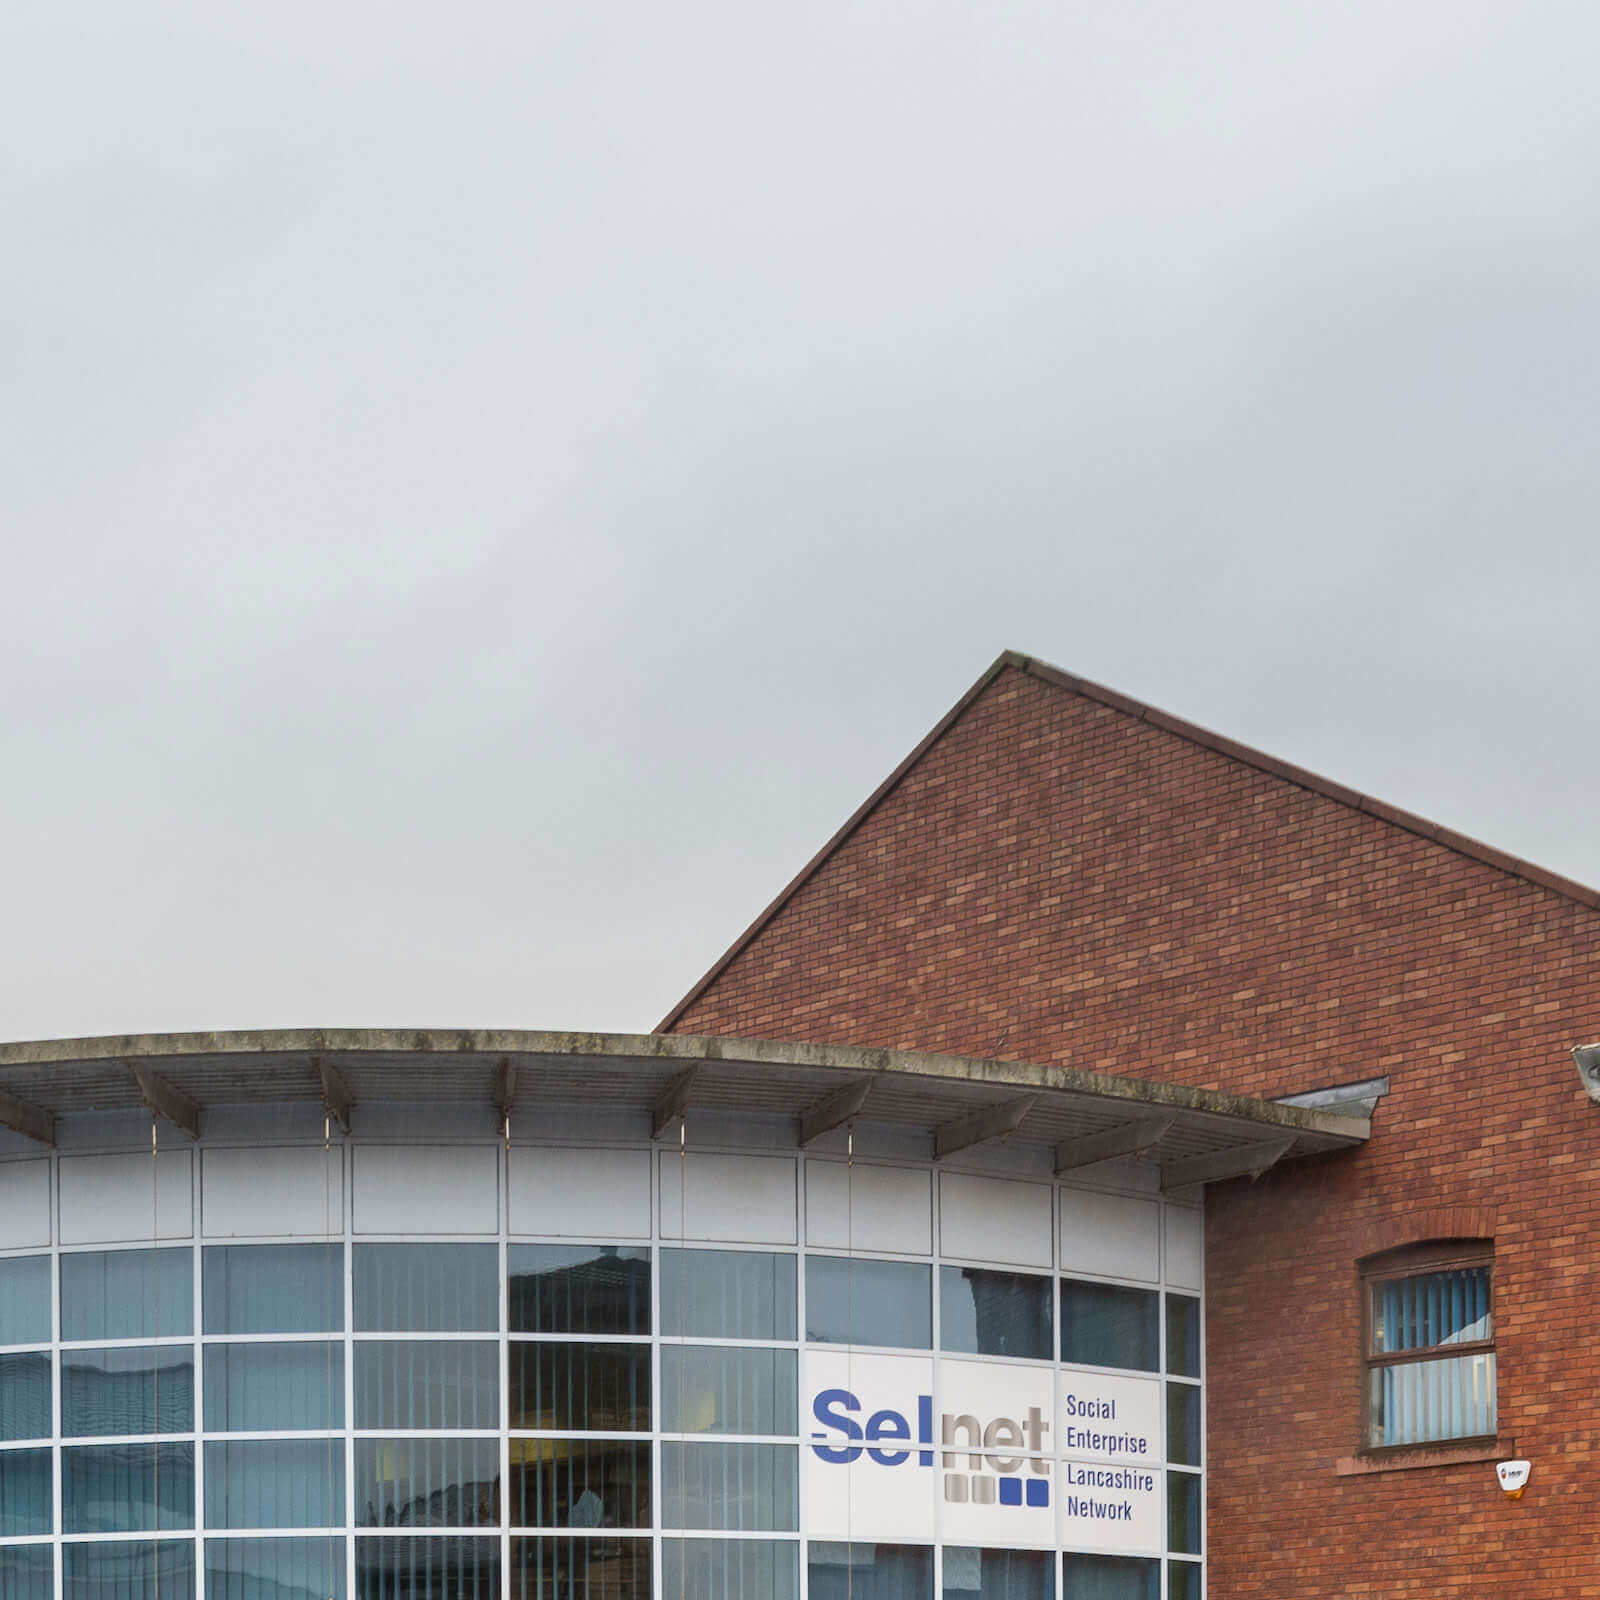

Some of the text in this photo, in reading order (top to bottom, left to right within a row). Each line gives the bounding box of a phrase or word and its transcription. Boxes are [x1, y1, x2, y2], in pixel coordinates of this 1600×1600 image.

[1067, 1394, 1116, 1420] Social
[812, 1389, 1049, 1475] Selnet
[1067, 1426, 1147, 1455] Enterprise
[1067, 1464, 1153, 1492] Lancashire
[1067, 1496, 1132, 1521] Network
